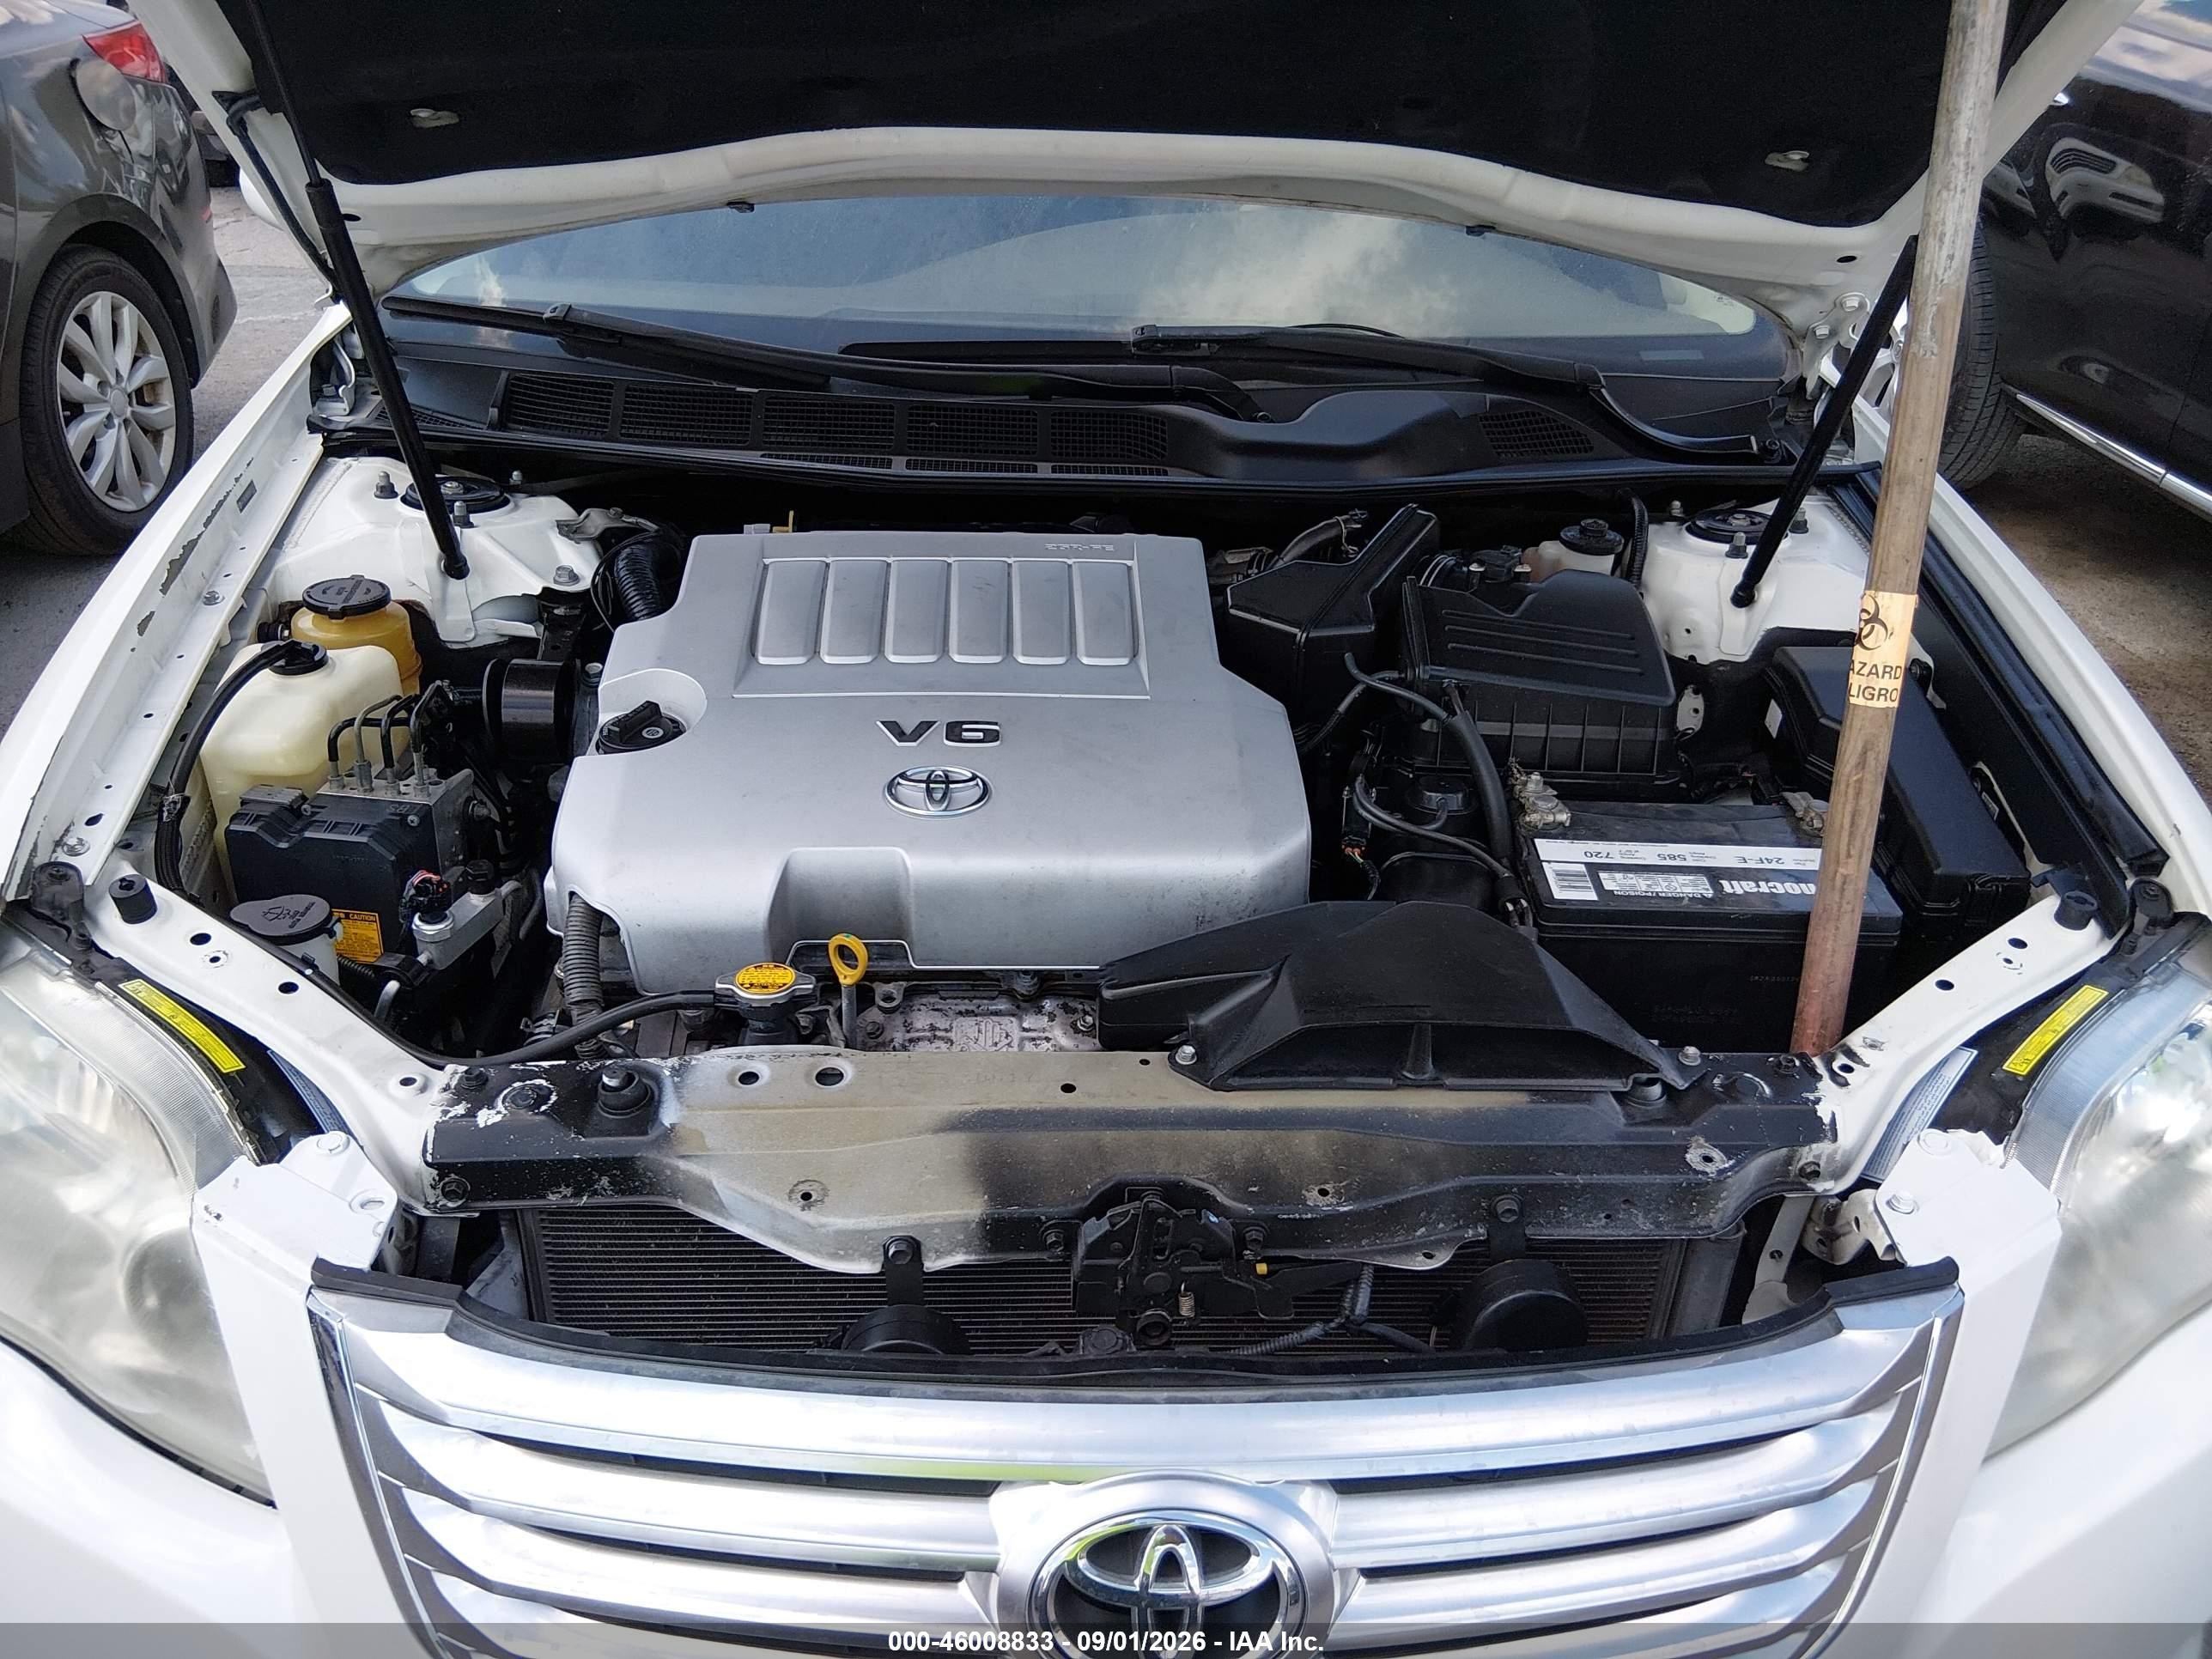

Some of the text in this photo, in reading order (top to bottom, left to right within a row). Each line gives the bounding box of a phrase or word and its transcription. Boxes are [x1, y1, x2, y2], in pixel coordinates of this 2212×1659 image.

[876, 720, 1002, 747] V6
[1583, 851, 1614, 860] 720
[1656, 853, 1687, 862] 585
[1734, 855, 1785, 866] 24F-E
[349, 913, 376, 921] CAUTION
